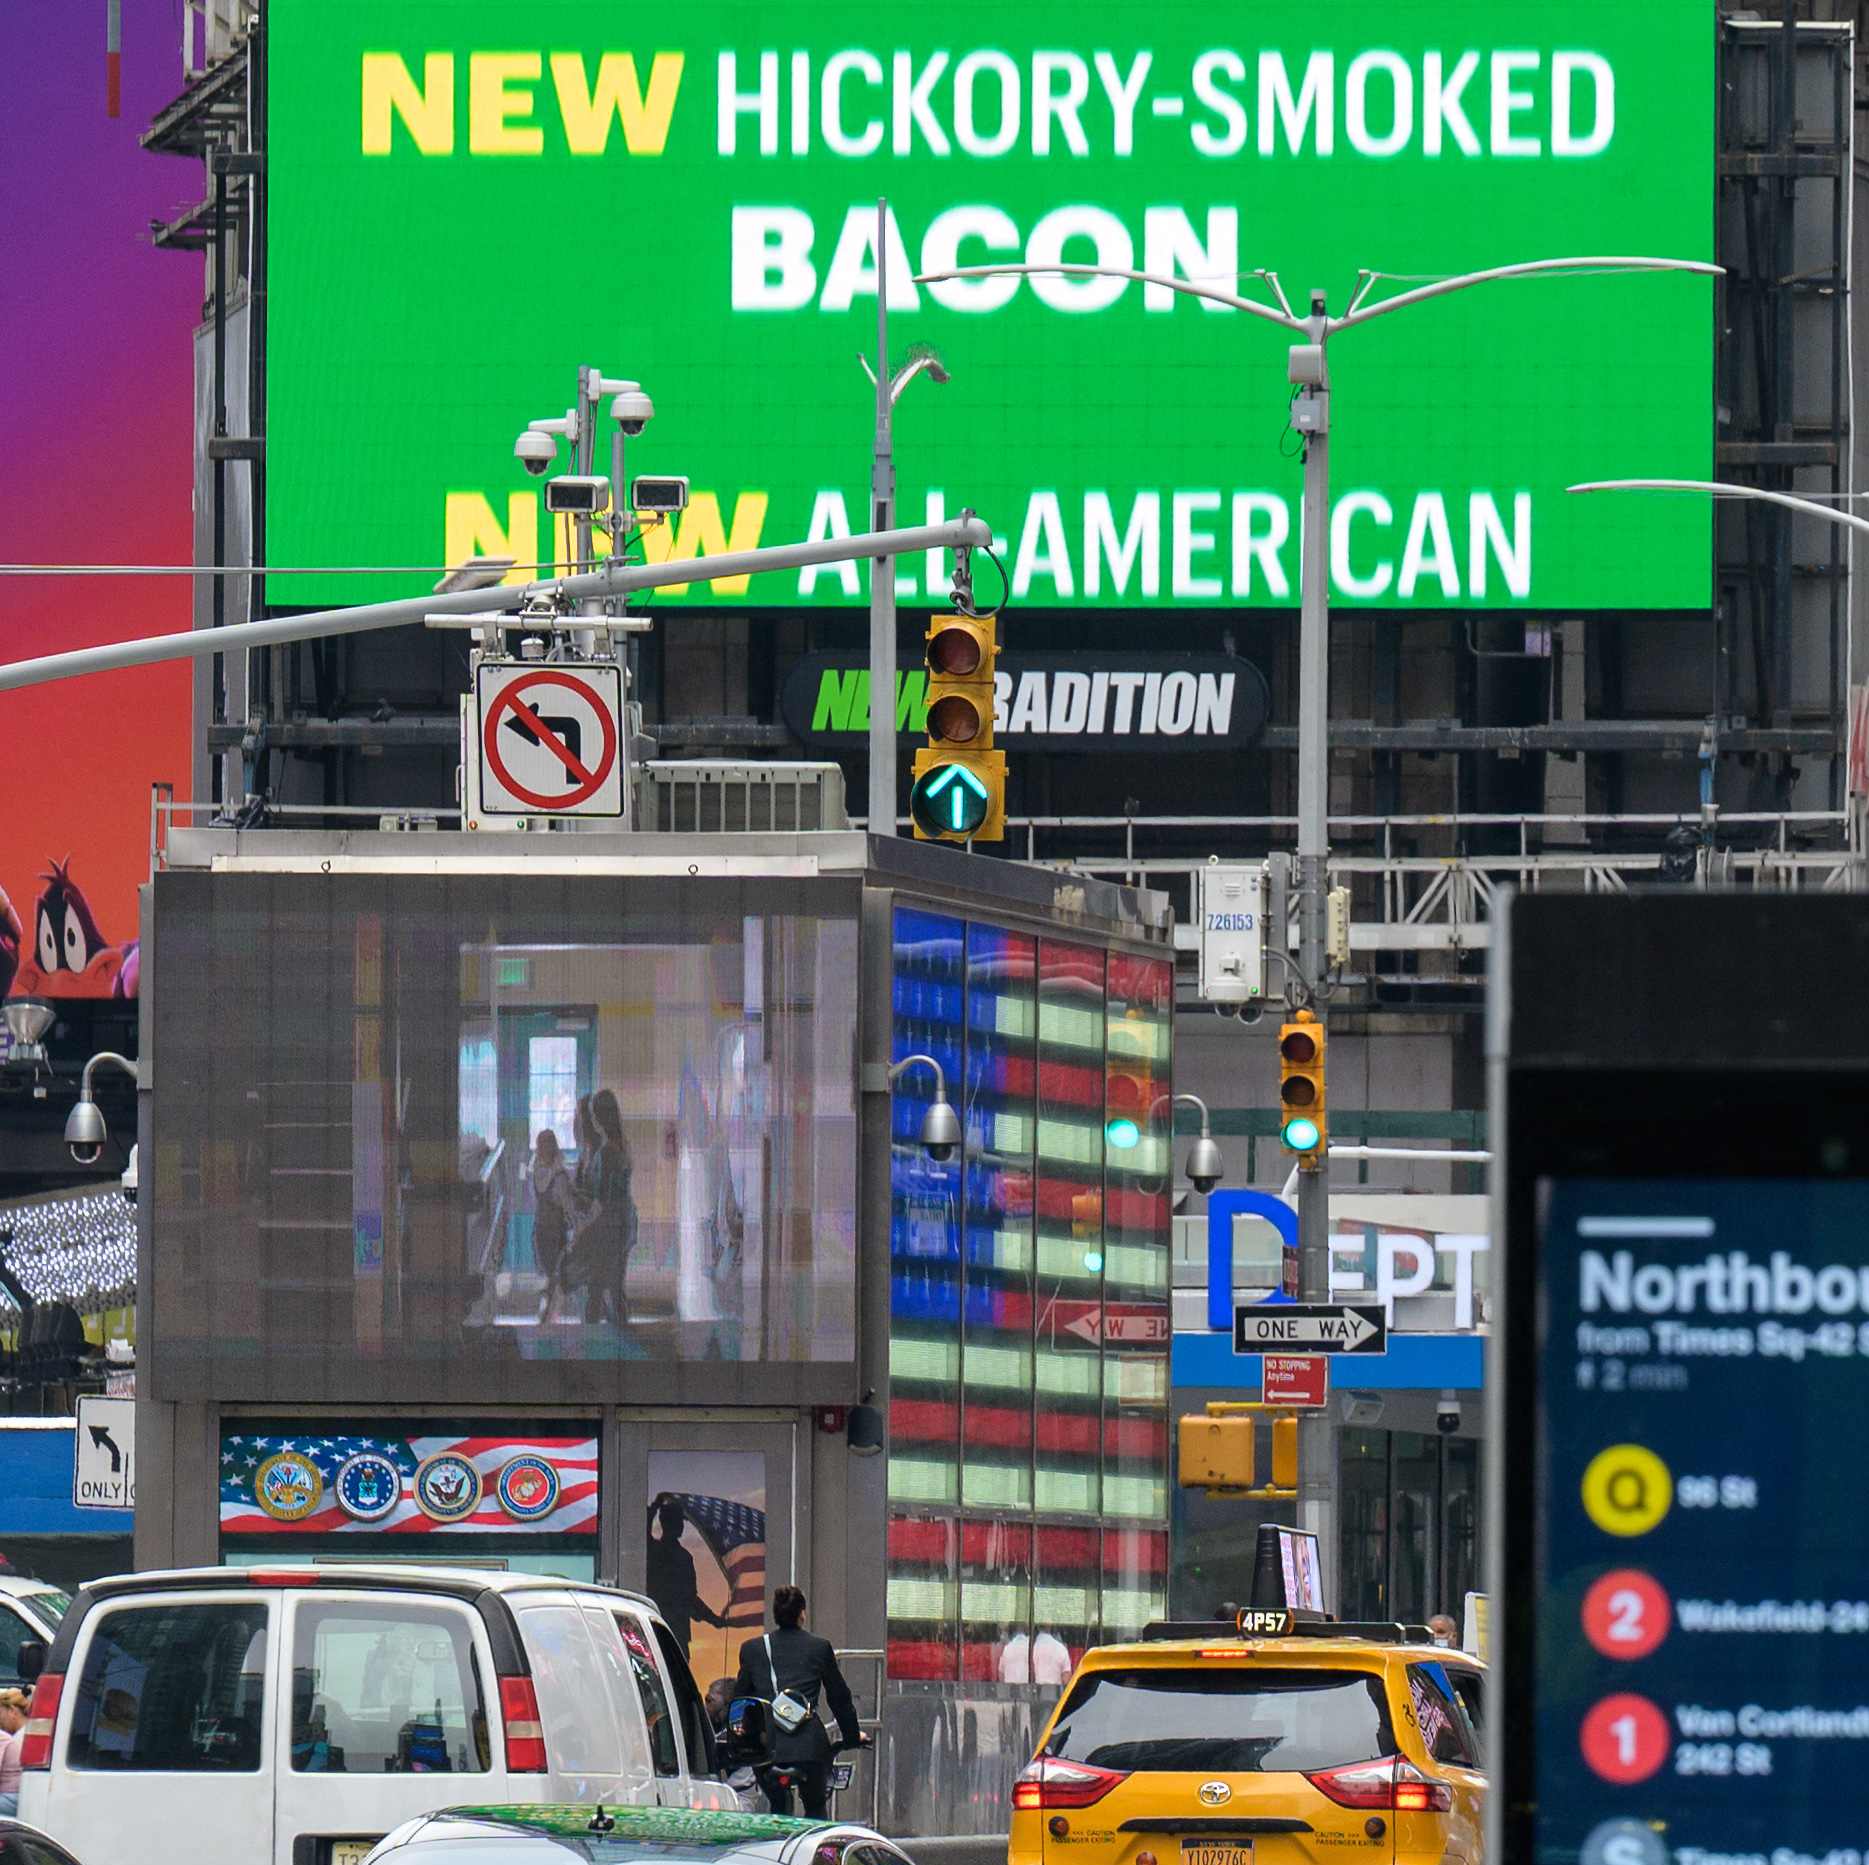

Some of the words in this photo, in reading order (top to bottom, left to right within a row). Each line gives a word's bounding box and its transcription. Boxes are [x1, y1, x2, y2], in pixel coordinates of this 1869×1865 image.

[360, 50, 684, 157] NEW
[717, 50, 1615, 158] HICKORY-SMOKED
[731, 206, 1240, 313] BACON
[445, 491, 769, 595] NW
[798, 491, 1531, 598] AL-AMERCAN
[992, 672, 1235, 735] RADITION
[1207, 913, 1253, 931] 726153
[1257, 1320, 1298, 1339] ONE
[1318, 1320, 1363, 1339] WAY
[1576, 1321, 1650, 1355] from
[1652, 1321, 1755, 1356] Times
[1757, 1321, 1856, 1362] Sq-42
[1266, 1359, 1277, 1369] NO
[1602, 1359, 1625, 1391] 2
[1628, 1362, 1688, 1390] min
[81, 1481, 121, 1499] ONLY
[1605, 1468, 1648, 1513] Q
[1679, 1477, 1716, 1508] 96
[1721, 1476, 1756, 1508] St
[1242, 1612, 1286, 1632] 4P57
[1609, 1590, 1640, 1640] 2
[1611, 1715, 1636, 1765] 1
[1677, 1707, 1733, 1737] Van
[1736, 1744, 1771, 1775] St
